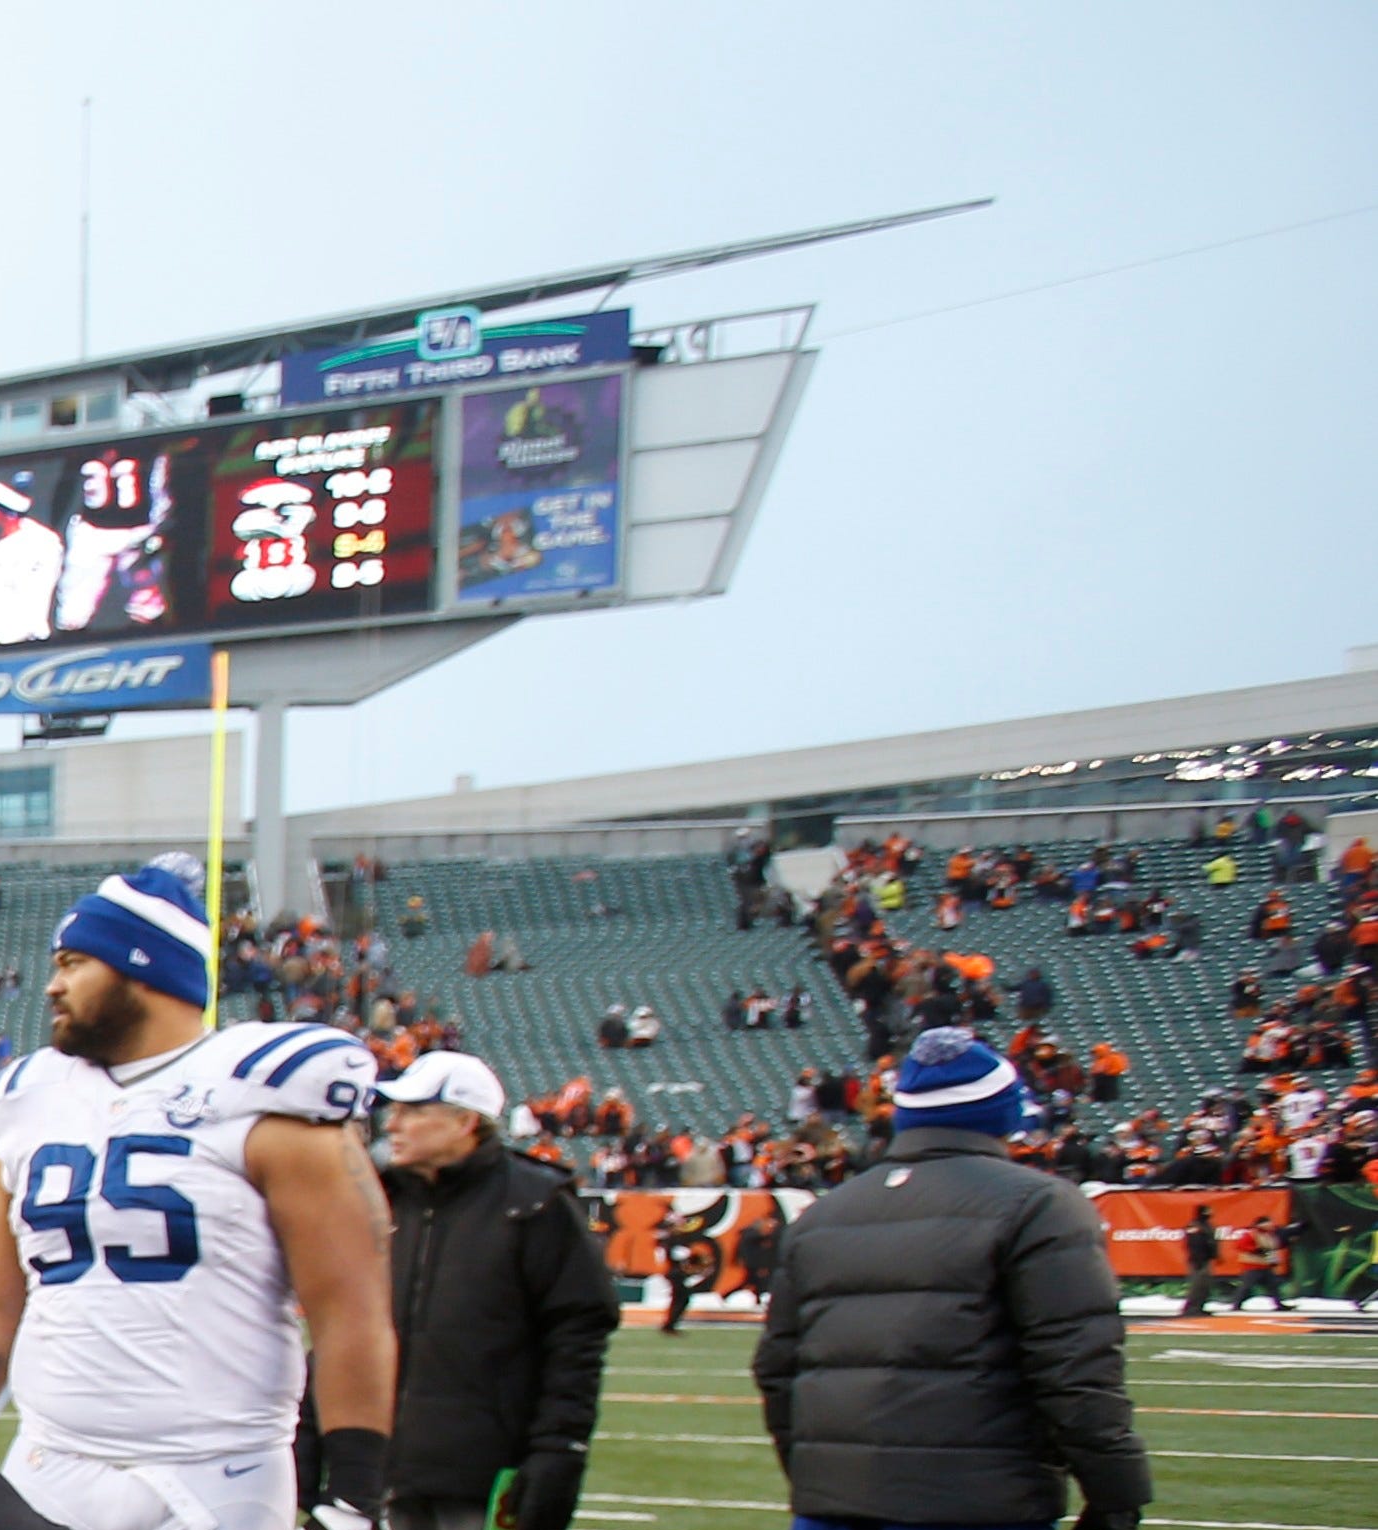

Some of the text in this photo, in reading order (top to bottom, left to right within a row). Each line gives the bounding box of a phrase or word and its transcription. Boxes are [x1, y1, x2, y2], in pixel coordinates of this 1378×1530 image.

[497, 342, 581, 373] BANK
[27, 654, 184, 698] LIGHT
[21, 1134, 201, 1285] 95
